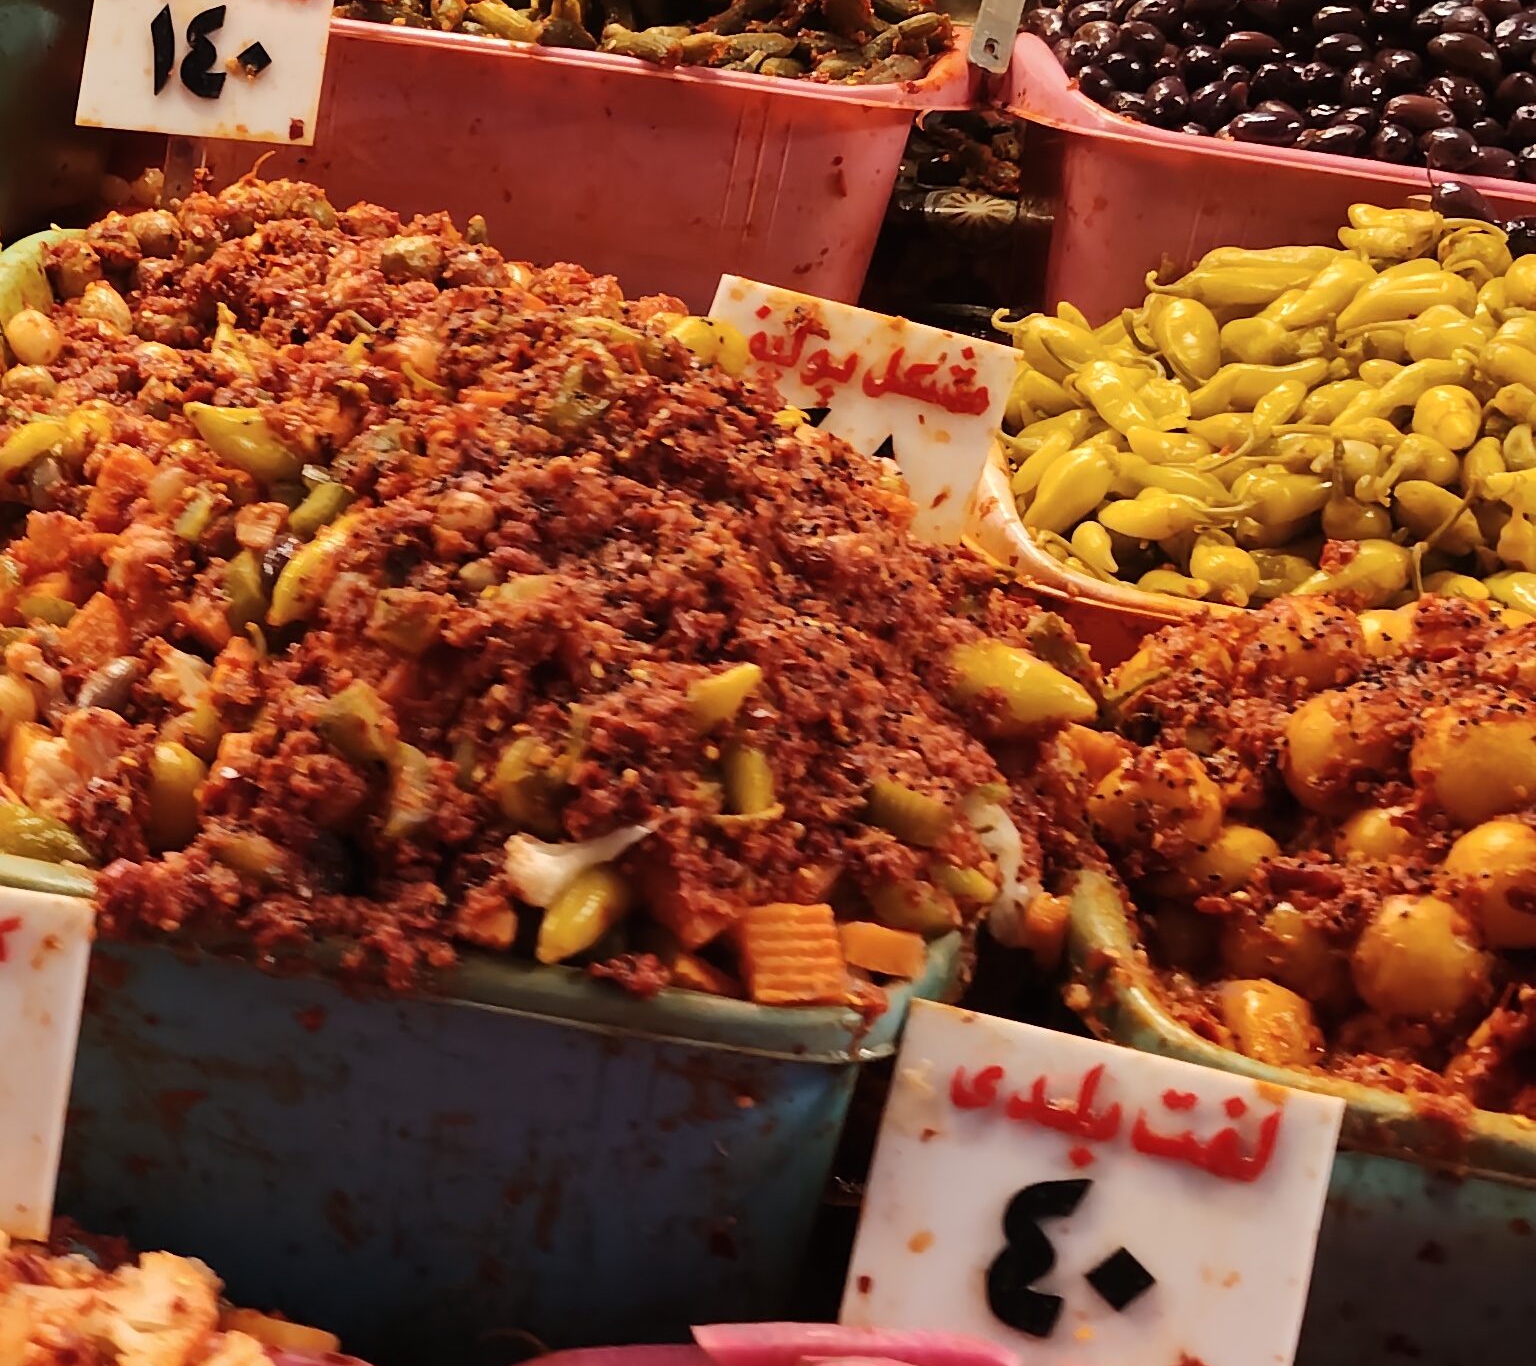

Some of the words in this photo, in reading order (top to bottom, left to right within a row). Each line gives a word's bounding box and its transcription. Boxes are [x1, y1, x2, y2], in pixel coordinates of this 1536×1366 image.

[150, 3, 273, 100] ١٤٠
[1131, 1088, 1283, 1183] لفت
[987, 1178, 1157, 1339] ٤٠
